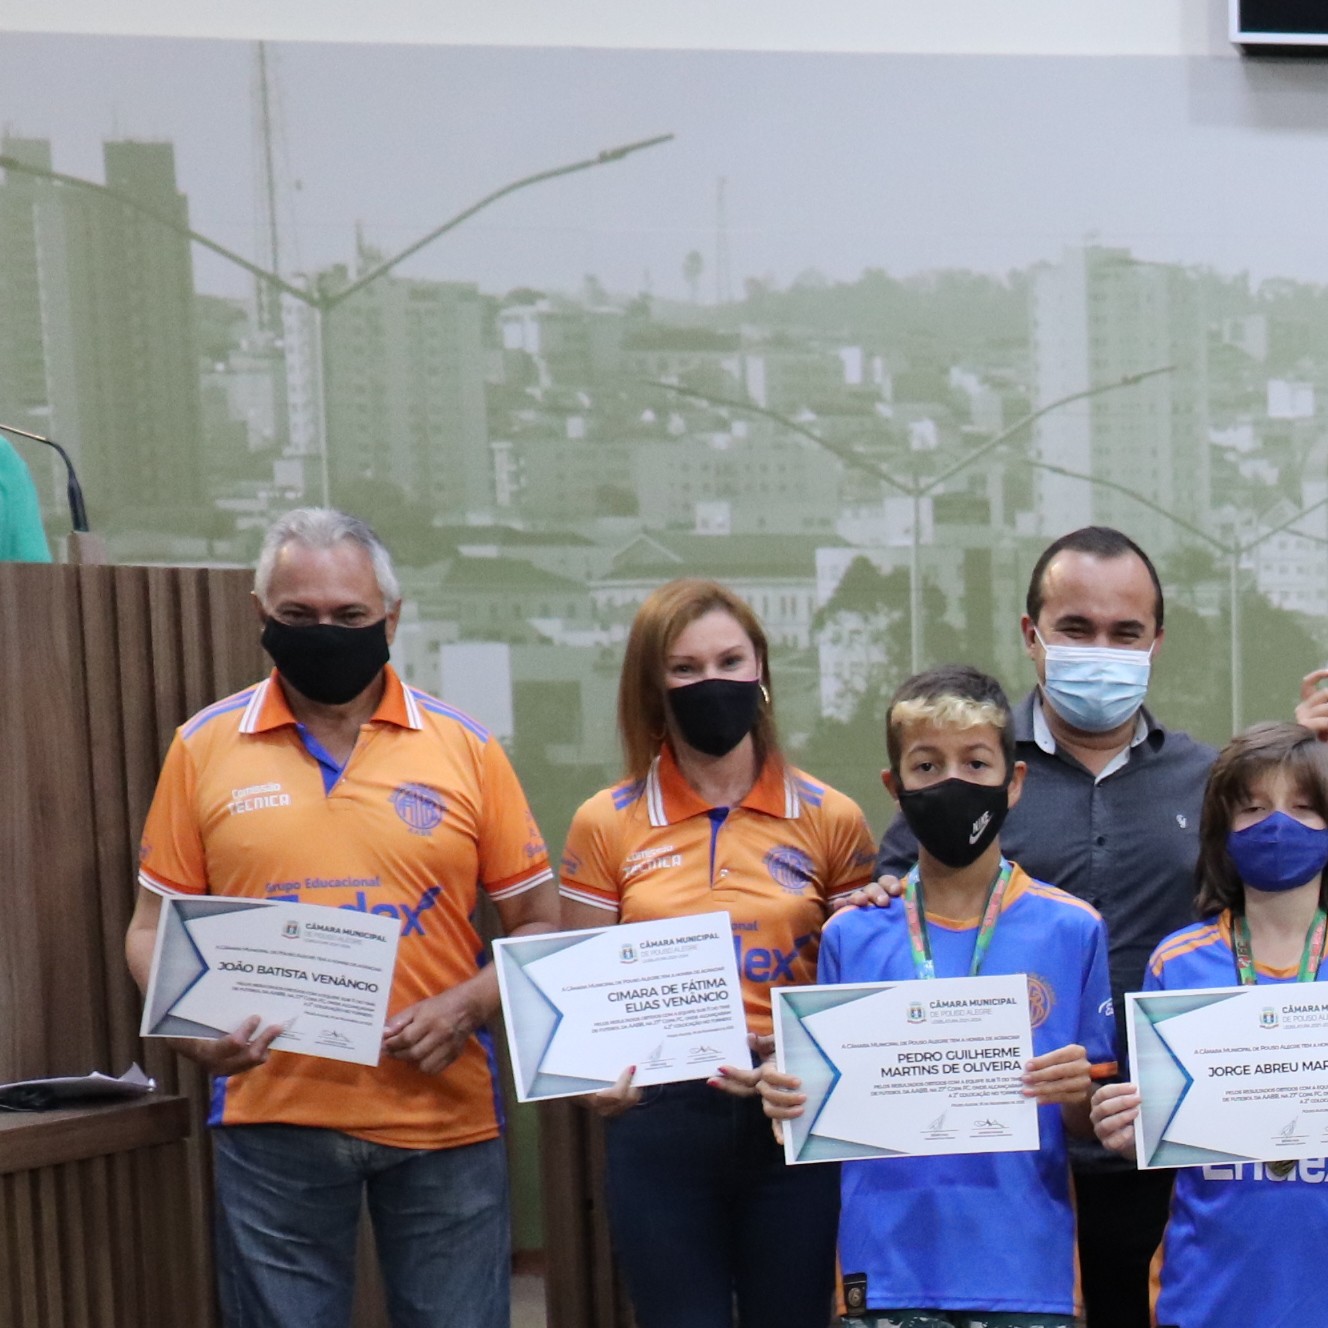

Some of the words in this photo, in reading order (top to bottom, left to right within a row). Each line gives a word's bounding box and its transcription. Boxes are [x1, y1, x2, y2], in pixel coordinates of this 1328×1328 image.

[304, 876, 381, 890] Educacional
[217, 960, 254, 973] JOÃO
[257, 963, 307, 980] BATISTA
[312, 972, 379, 993] VENÂNCIO
[608, 987, 658, 1002] CIMARA
[661, 982, 679, 995] DE
[681, 978, 727, 993] FÁTIMA
[625, 1000, 660, 1014] ELIAS
[663, 989, 729, 1009] VENÂNCIO
[929, 998, 967, 1009] CÂMARA
[969, 997, 1017, 1006] MUNICIPAL
[1281, 1003, 1319, 1014] CÂMARA
[898, 1052, 942, 1064] PEDRO
[946, 1047, 1020, 1060] GUILHERME
[881, 1065, 939, 1078] MARTINS
[943, 1063, 960, 1074] DE
[963, 1060, 1021, 1073] OLIVEIRA
[1208, 1064, 1250, 1078] JORGE
[1254, 1061, 1298, 1075] ABREU
